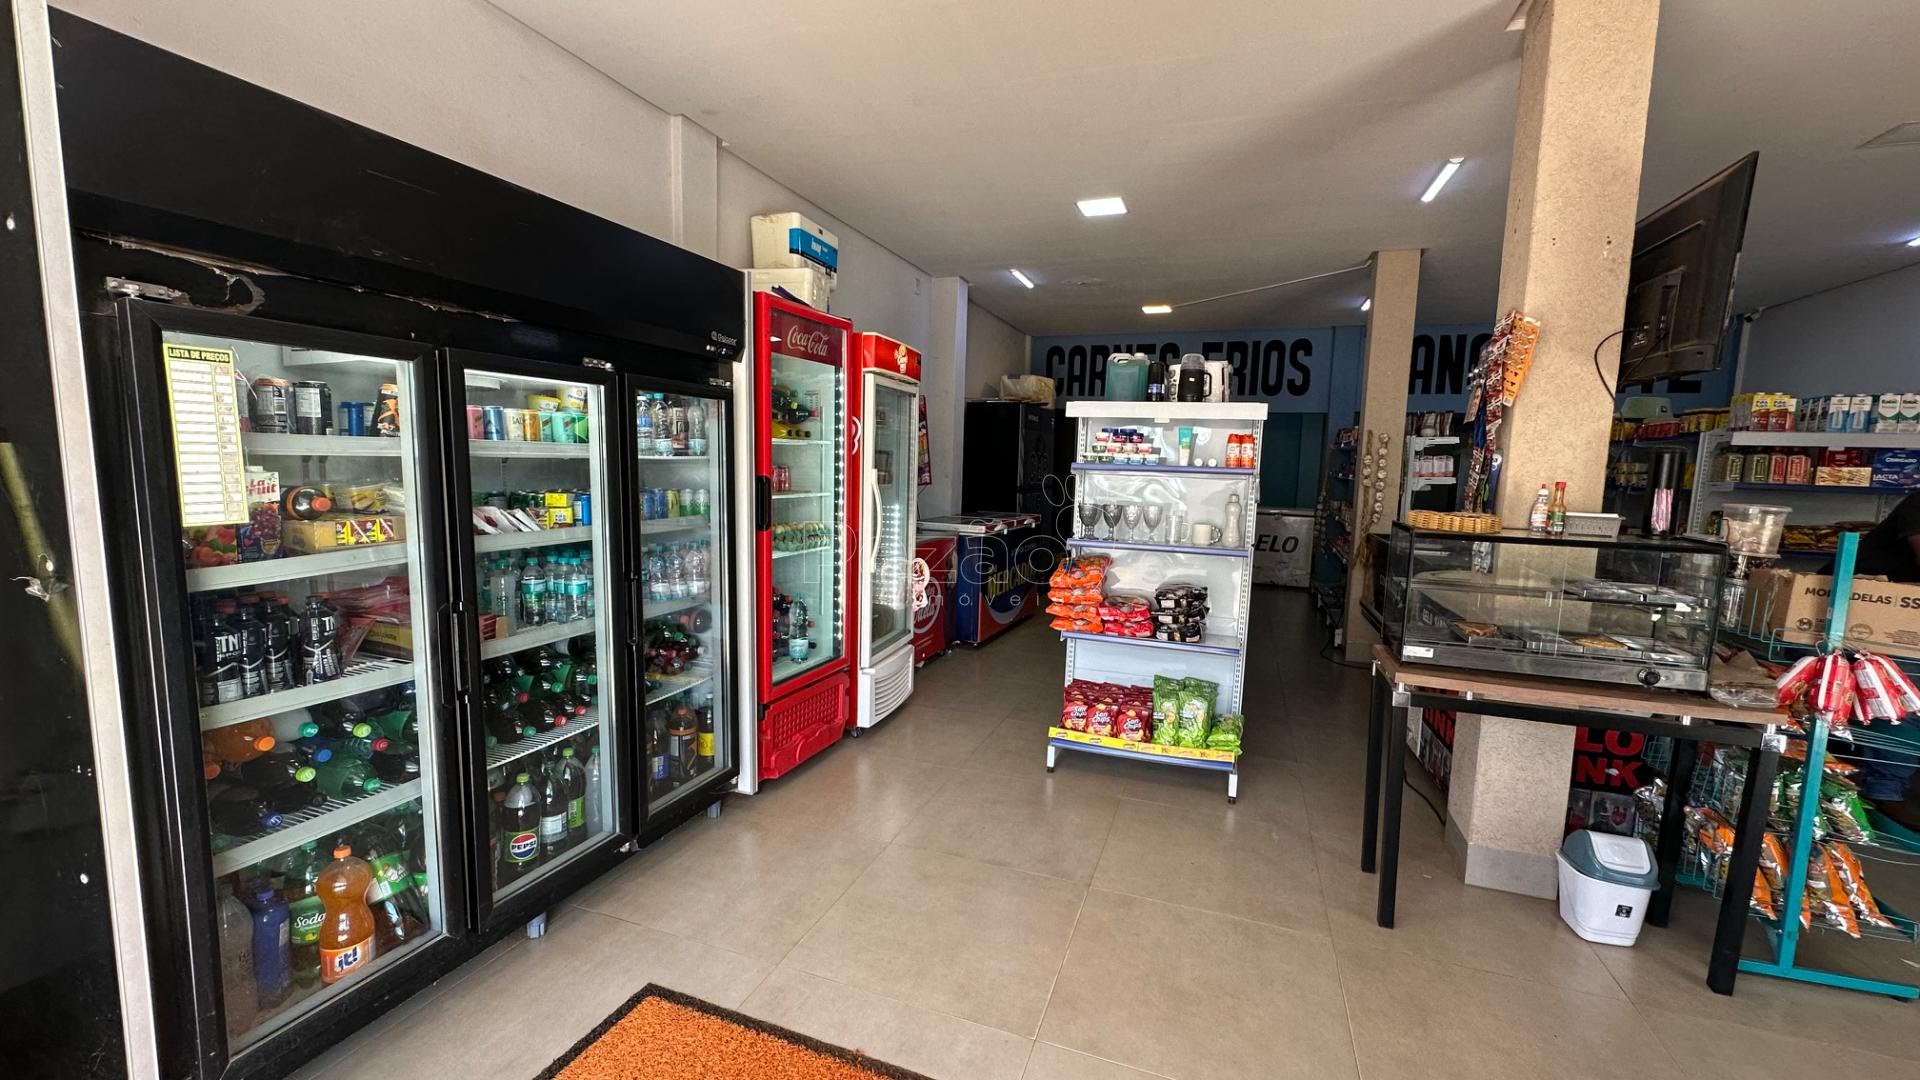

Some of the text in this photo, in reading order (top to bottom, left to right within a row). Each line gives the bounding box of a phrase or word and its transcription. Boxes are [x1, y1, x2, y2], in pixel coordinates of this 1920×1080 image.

[788, 325, 829, 356] Coca-Cola
[168, 347, 229, 362] LISTA DE PREÇOS
[1046, 343, 1181, 397] CAR
[1804, 587, 1892, 605] MODELAS
[511, 840, 537, 851] PEPSI
[294, 911, 327, 929] Soda
